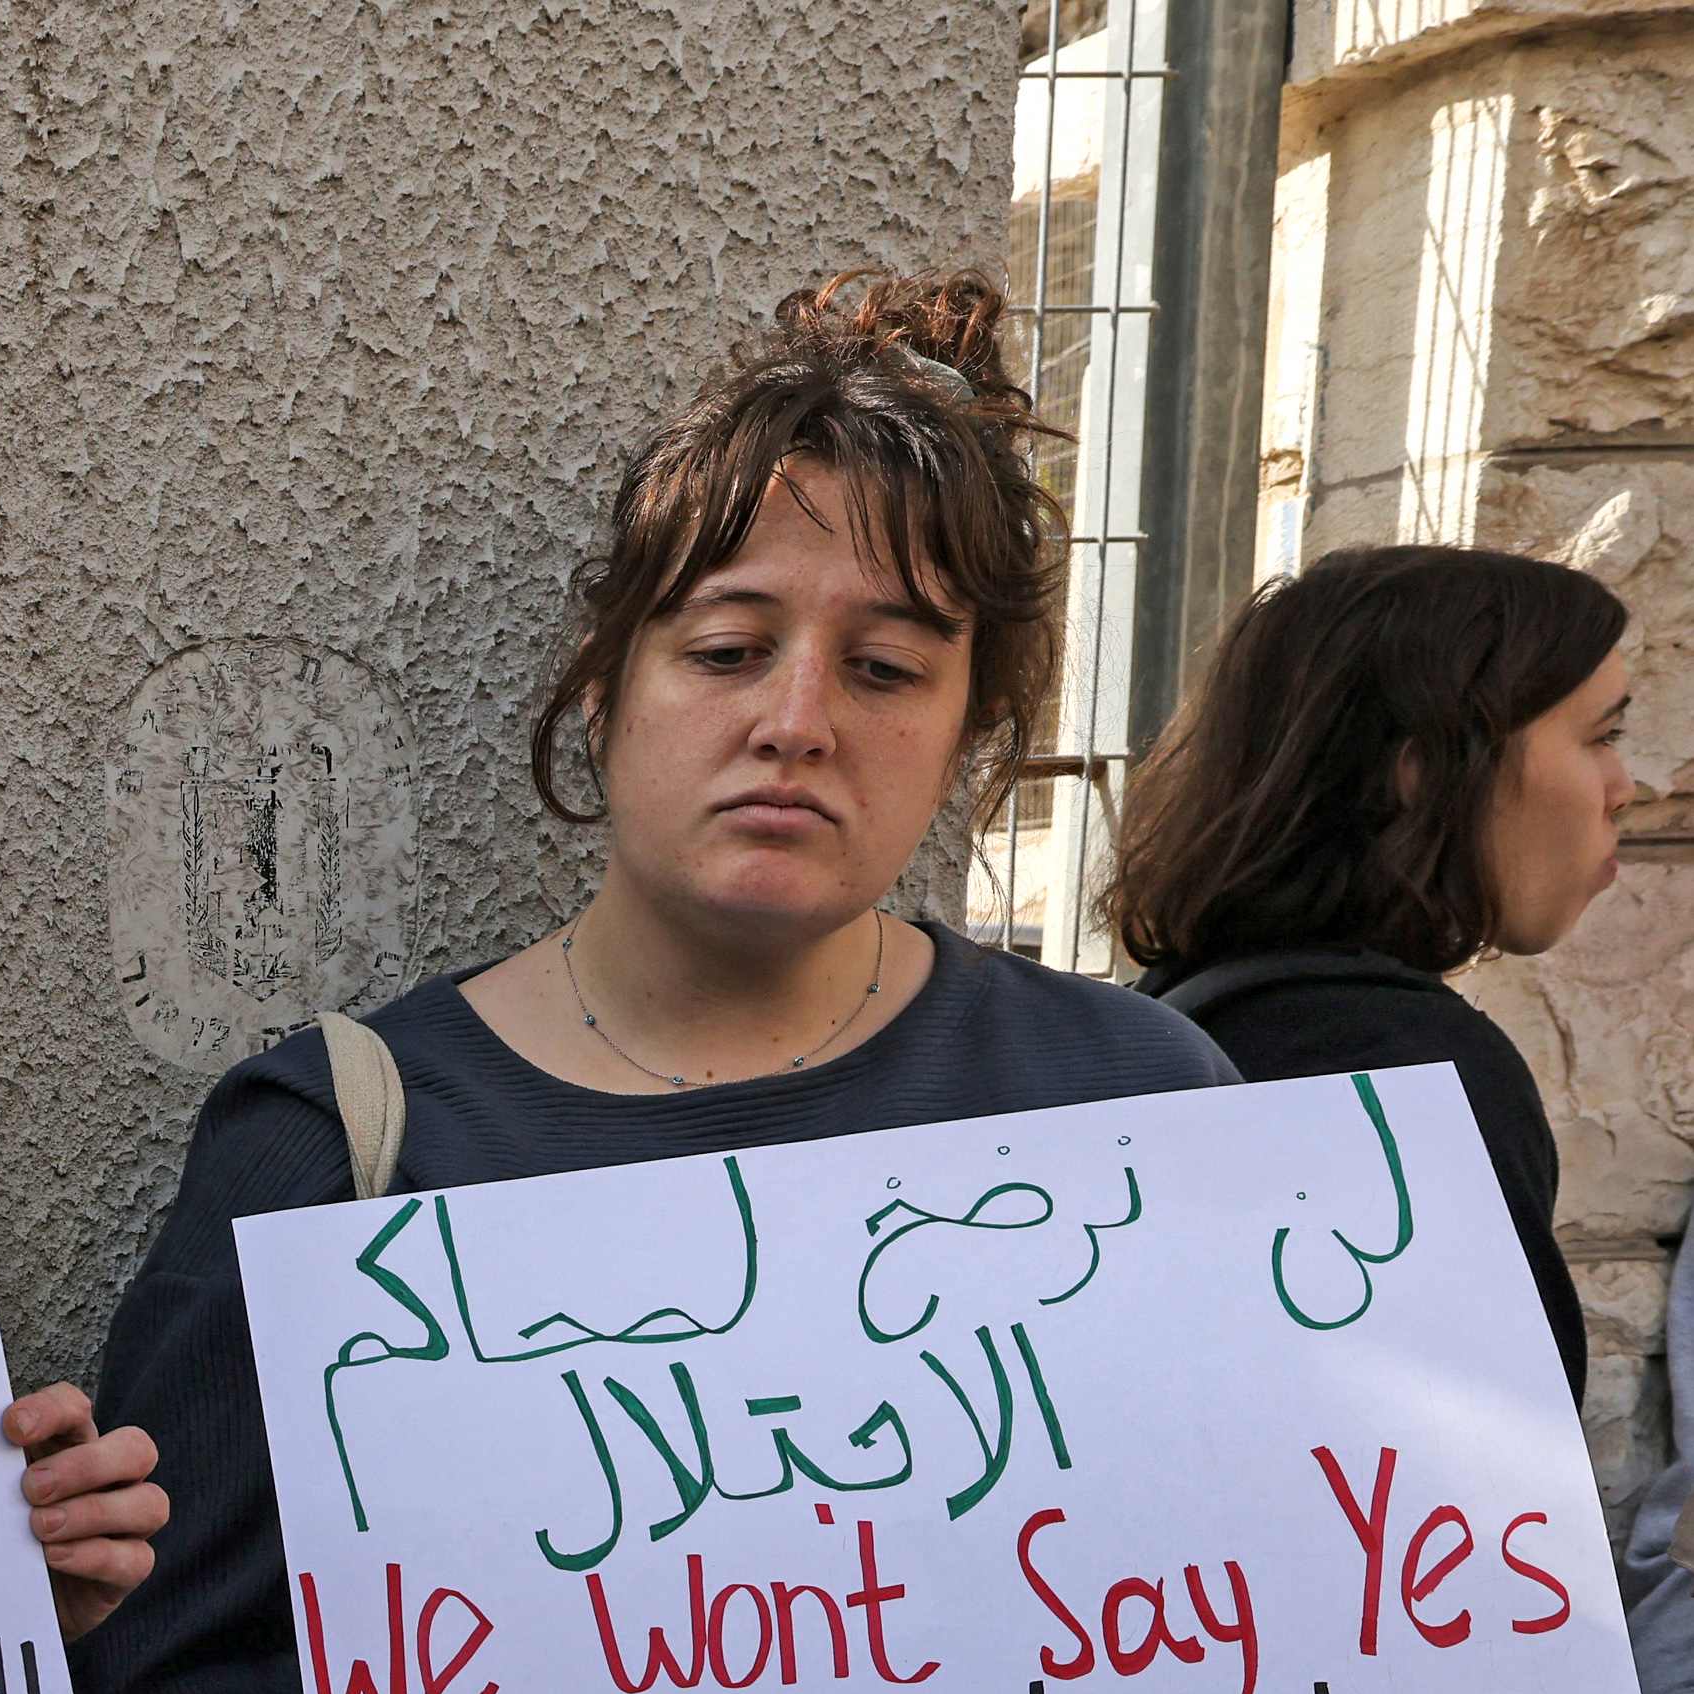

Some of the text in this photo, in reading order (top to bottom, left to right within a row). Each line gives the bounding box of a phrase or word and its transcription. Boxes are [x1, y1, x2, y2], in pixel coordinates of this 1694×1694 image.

[858, 1135, 1143, 1344] نرضخ
[1271, 1073, 1414, 1331] لن
[535, 1323, 1072, 1572] الاحتلال
[585, 1504, 941, 1694] Won't
[1311, 1446, 1570, 1656] Yes
